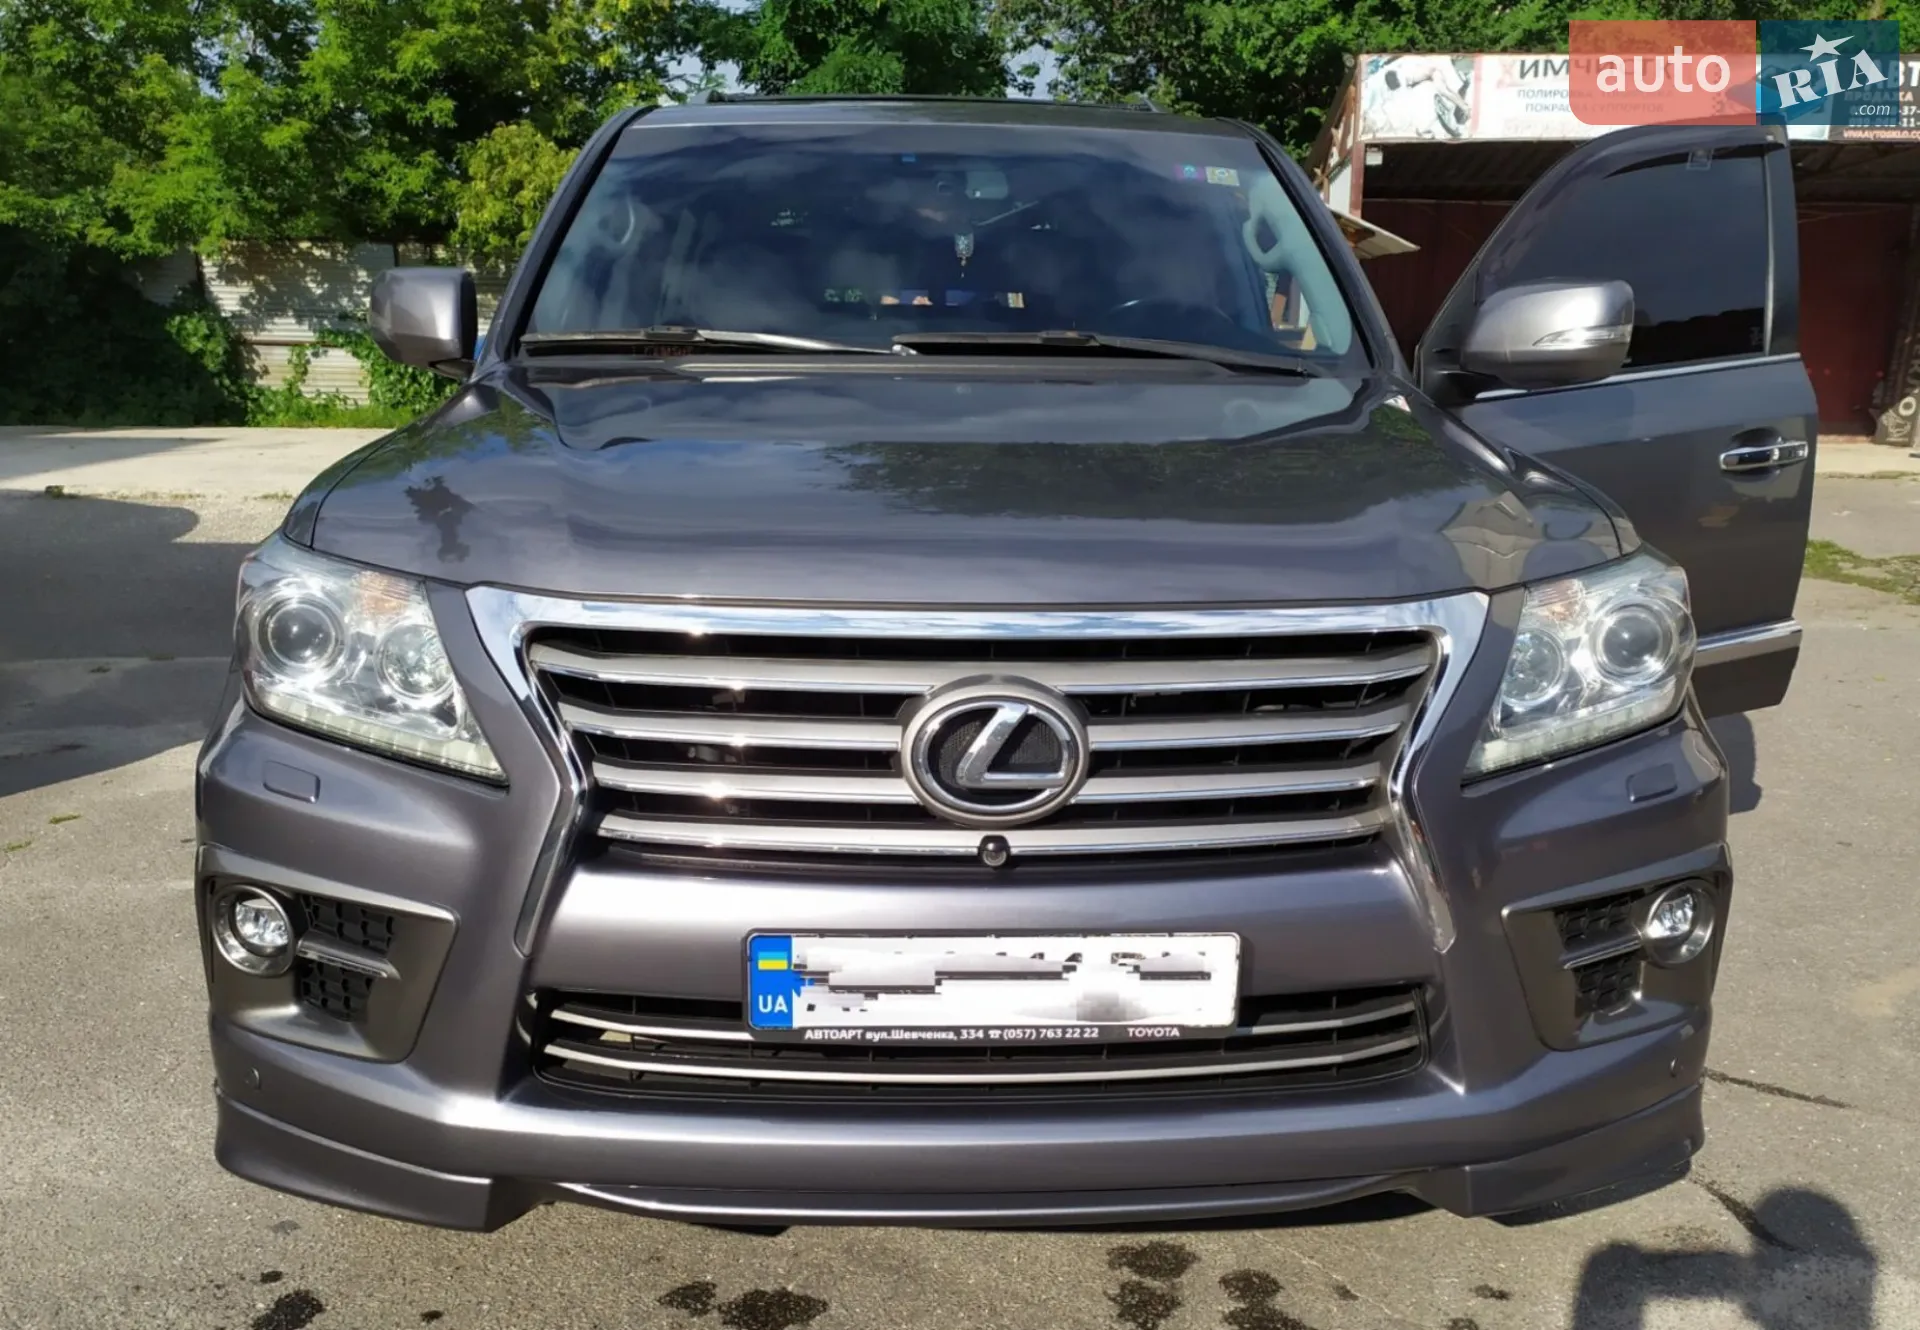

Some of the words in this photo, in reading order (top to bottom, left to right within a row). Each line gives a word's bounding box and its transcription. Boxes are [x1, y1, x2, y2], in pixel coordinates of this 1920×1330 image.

[758, 994, 788, 1014] UA
[804, 1029, 863, 1040] АВТОАРТ
[960, 1028, 984, 1039] 334
[1003, 1027, 1036, 1040] (057)
[1039, 1027, 1062, 1038] 763
[1065, 1027, 1081, 1038] 22
[1083, 1027, 1099, 1038] 22
[1127, 1026, 1180, 1037] TOYOTA
